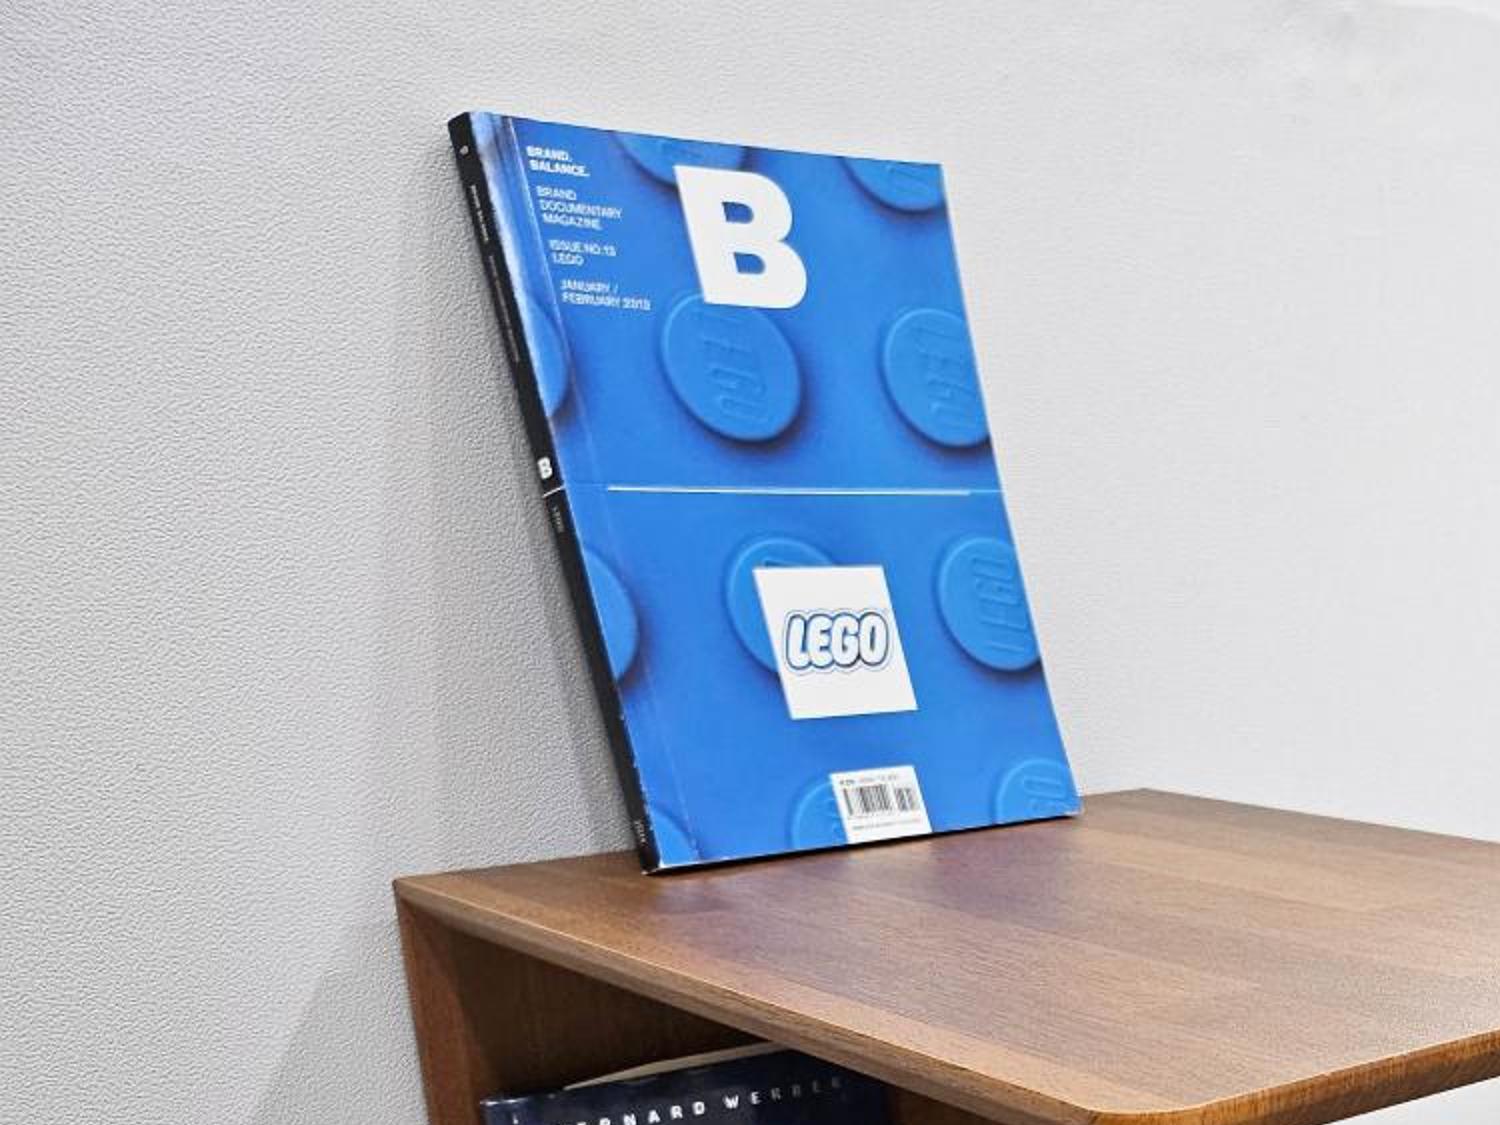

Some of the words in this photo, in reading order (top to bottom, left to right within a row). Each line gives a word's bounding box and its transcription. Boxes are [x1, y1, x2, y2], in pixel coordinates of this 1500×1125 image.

[539, 199, 623, 219] DOCUMENTARY
[542, 213, 603, 230] MAGAZINE
[672, 164, 807, 309] B
[537, 457, 553, 480] B
[785, 610, 890, 671] LEGO
